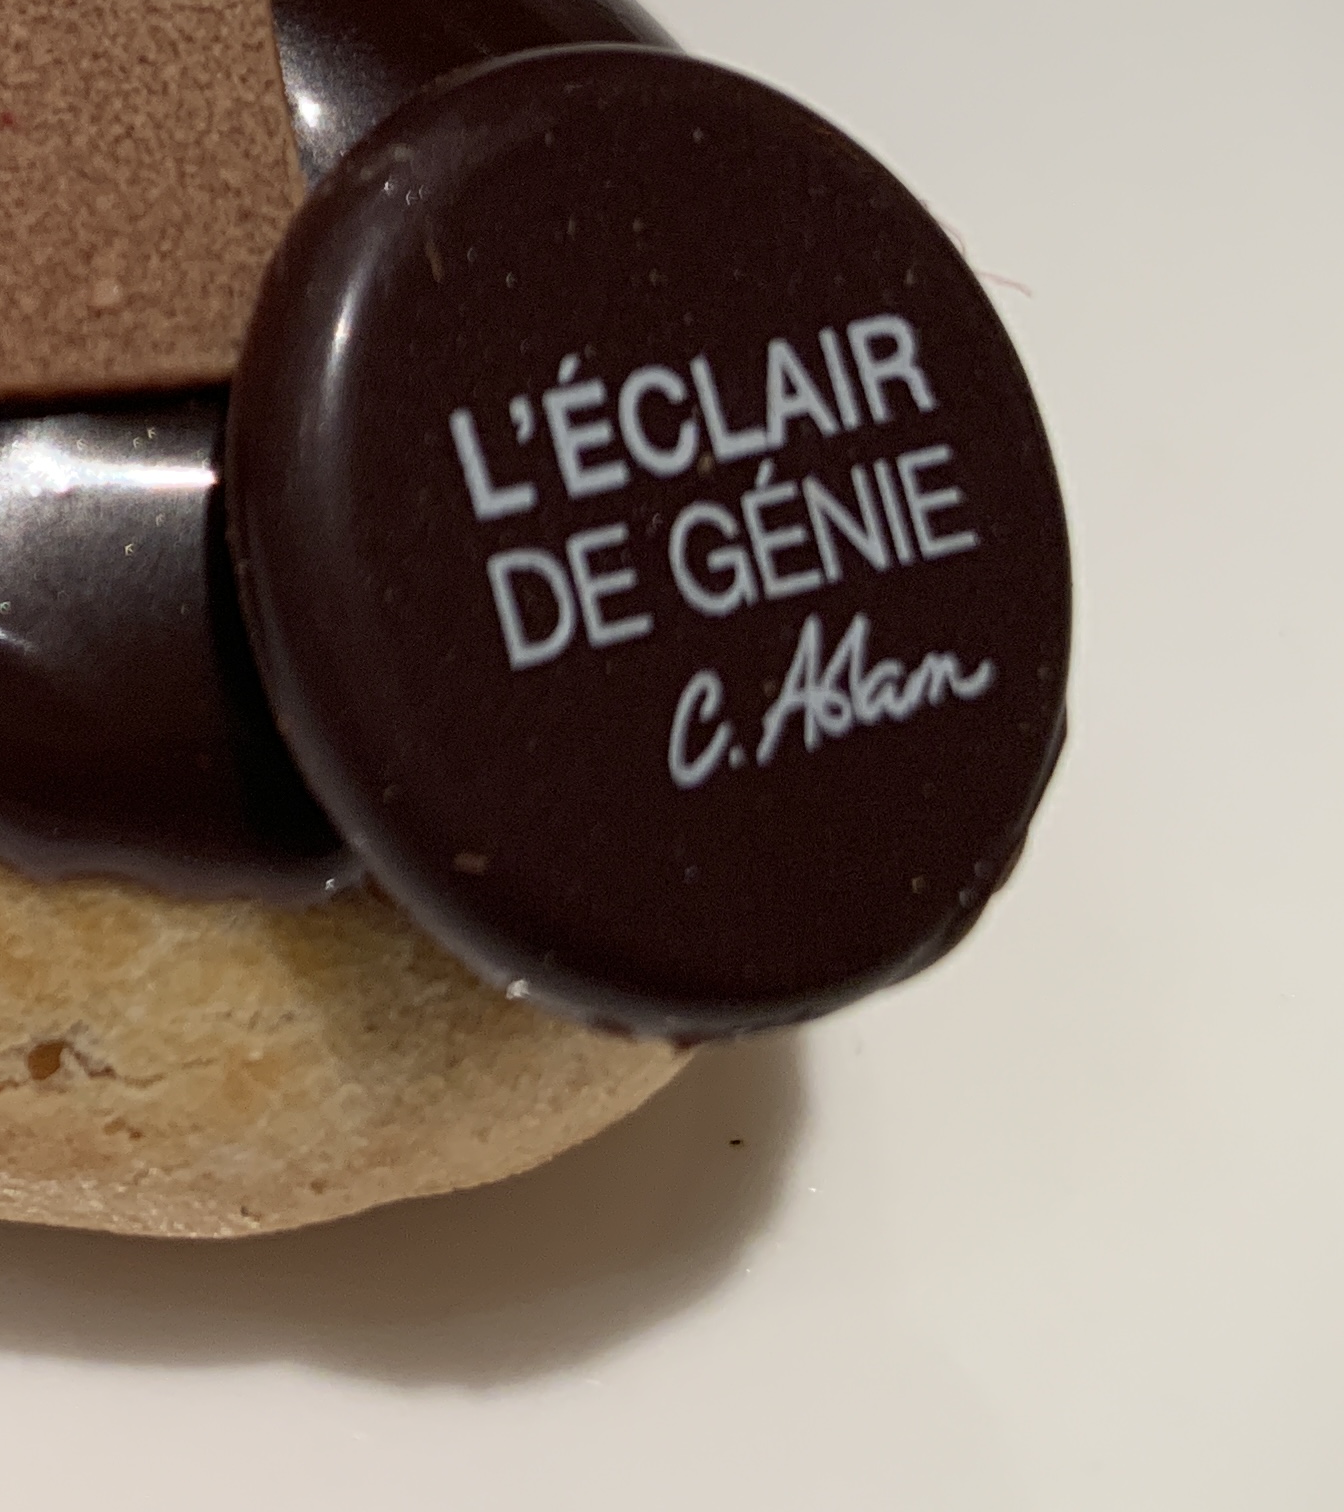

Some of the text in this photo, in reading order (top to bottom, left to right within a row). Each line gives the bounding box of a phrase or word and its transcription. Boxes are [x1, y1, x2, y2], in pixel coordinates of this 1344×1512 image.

[451, 315, 934, 521] L'ÉCLAIR
[487, 445, 978, 669] DE GÉNIE
[668, 672, 746, 788] C.
